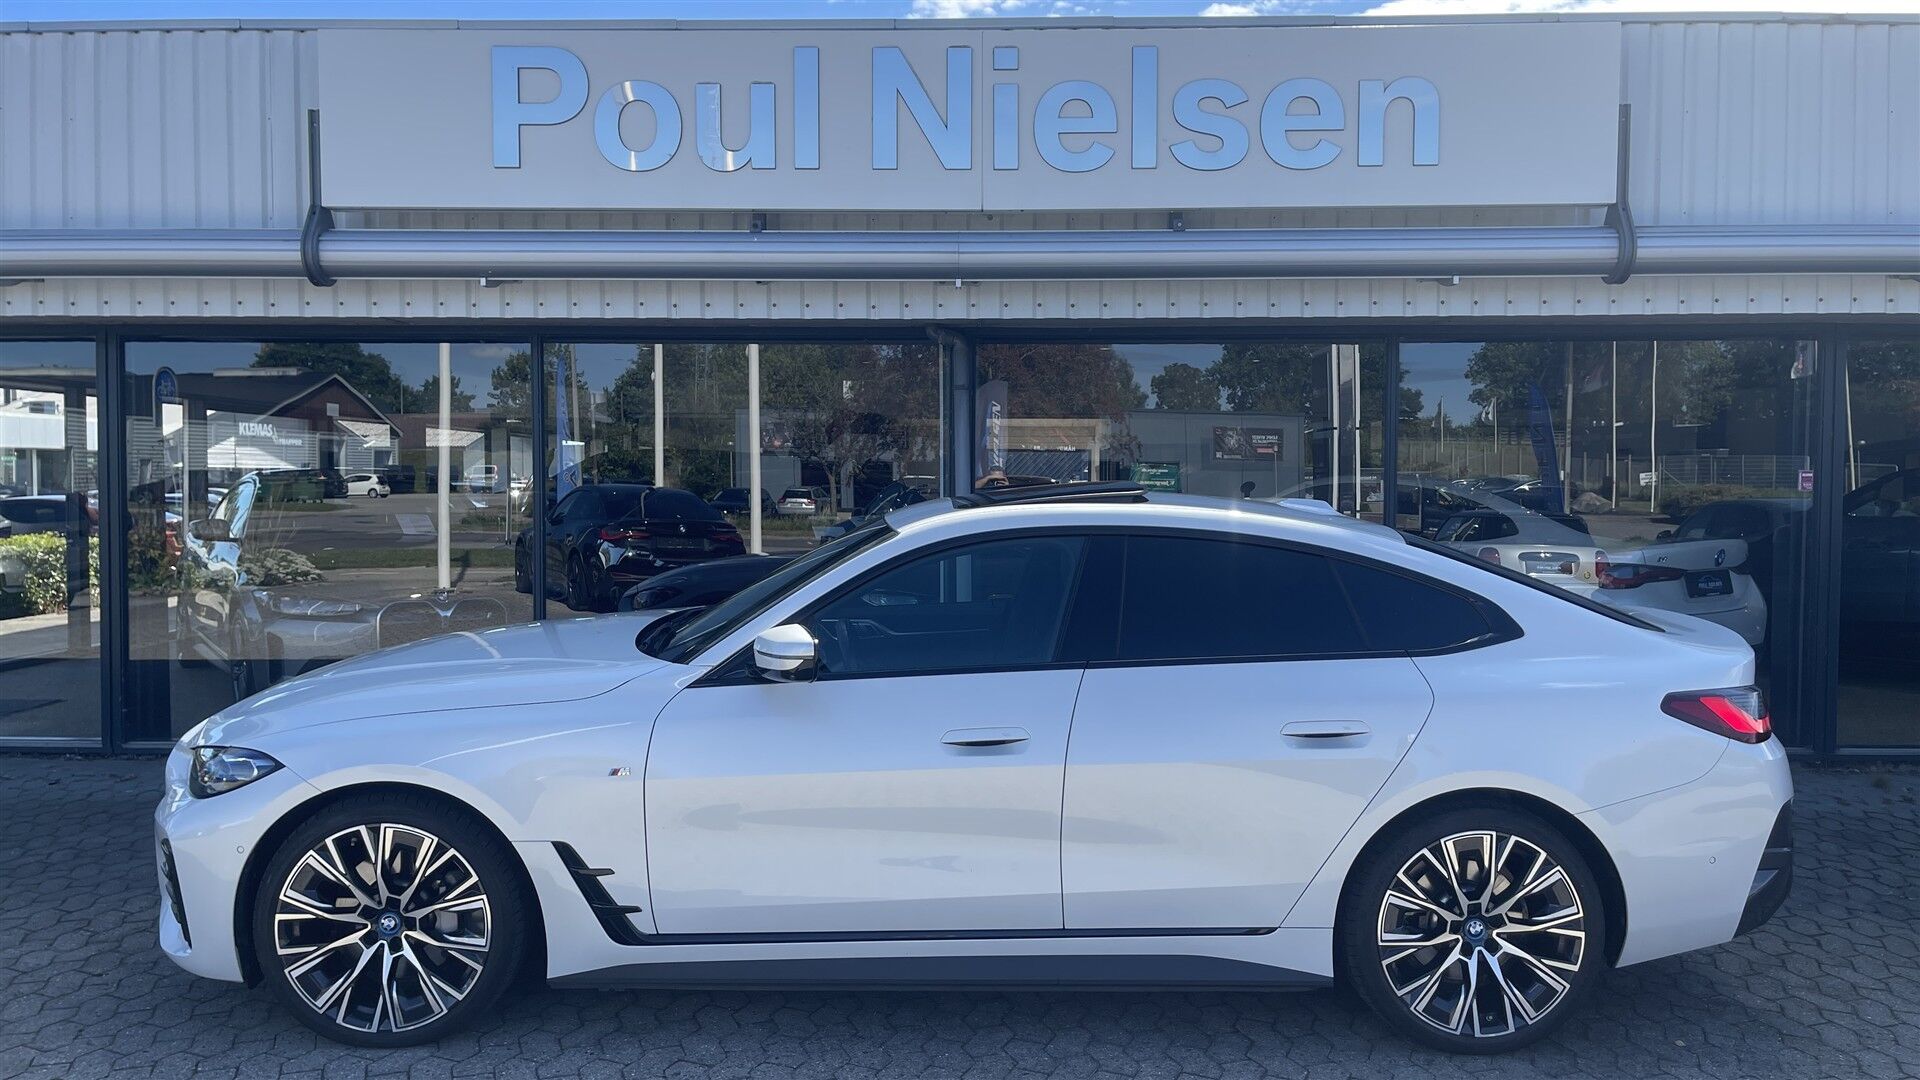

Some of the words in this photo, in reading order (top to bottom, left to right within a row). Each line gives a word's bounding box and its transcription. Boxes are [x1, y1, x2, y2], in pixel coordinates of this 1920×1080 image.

[491, 46, 820, 172] Poul
[872, 45, 1440, 173] Nielsen
[239, 422, 273, 437] KLEMAS
